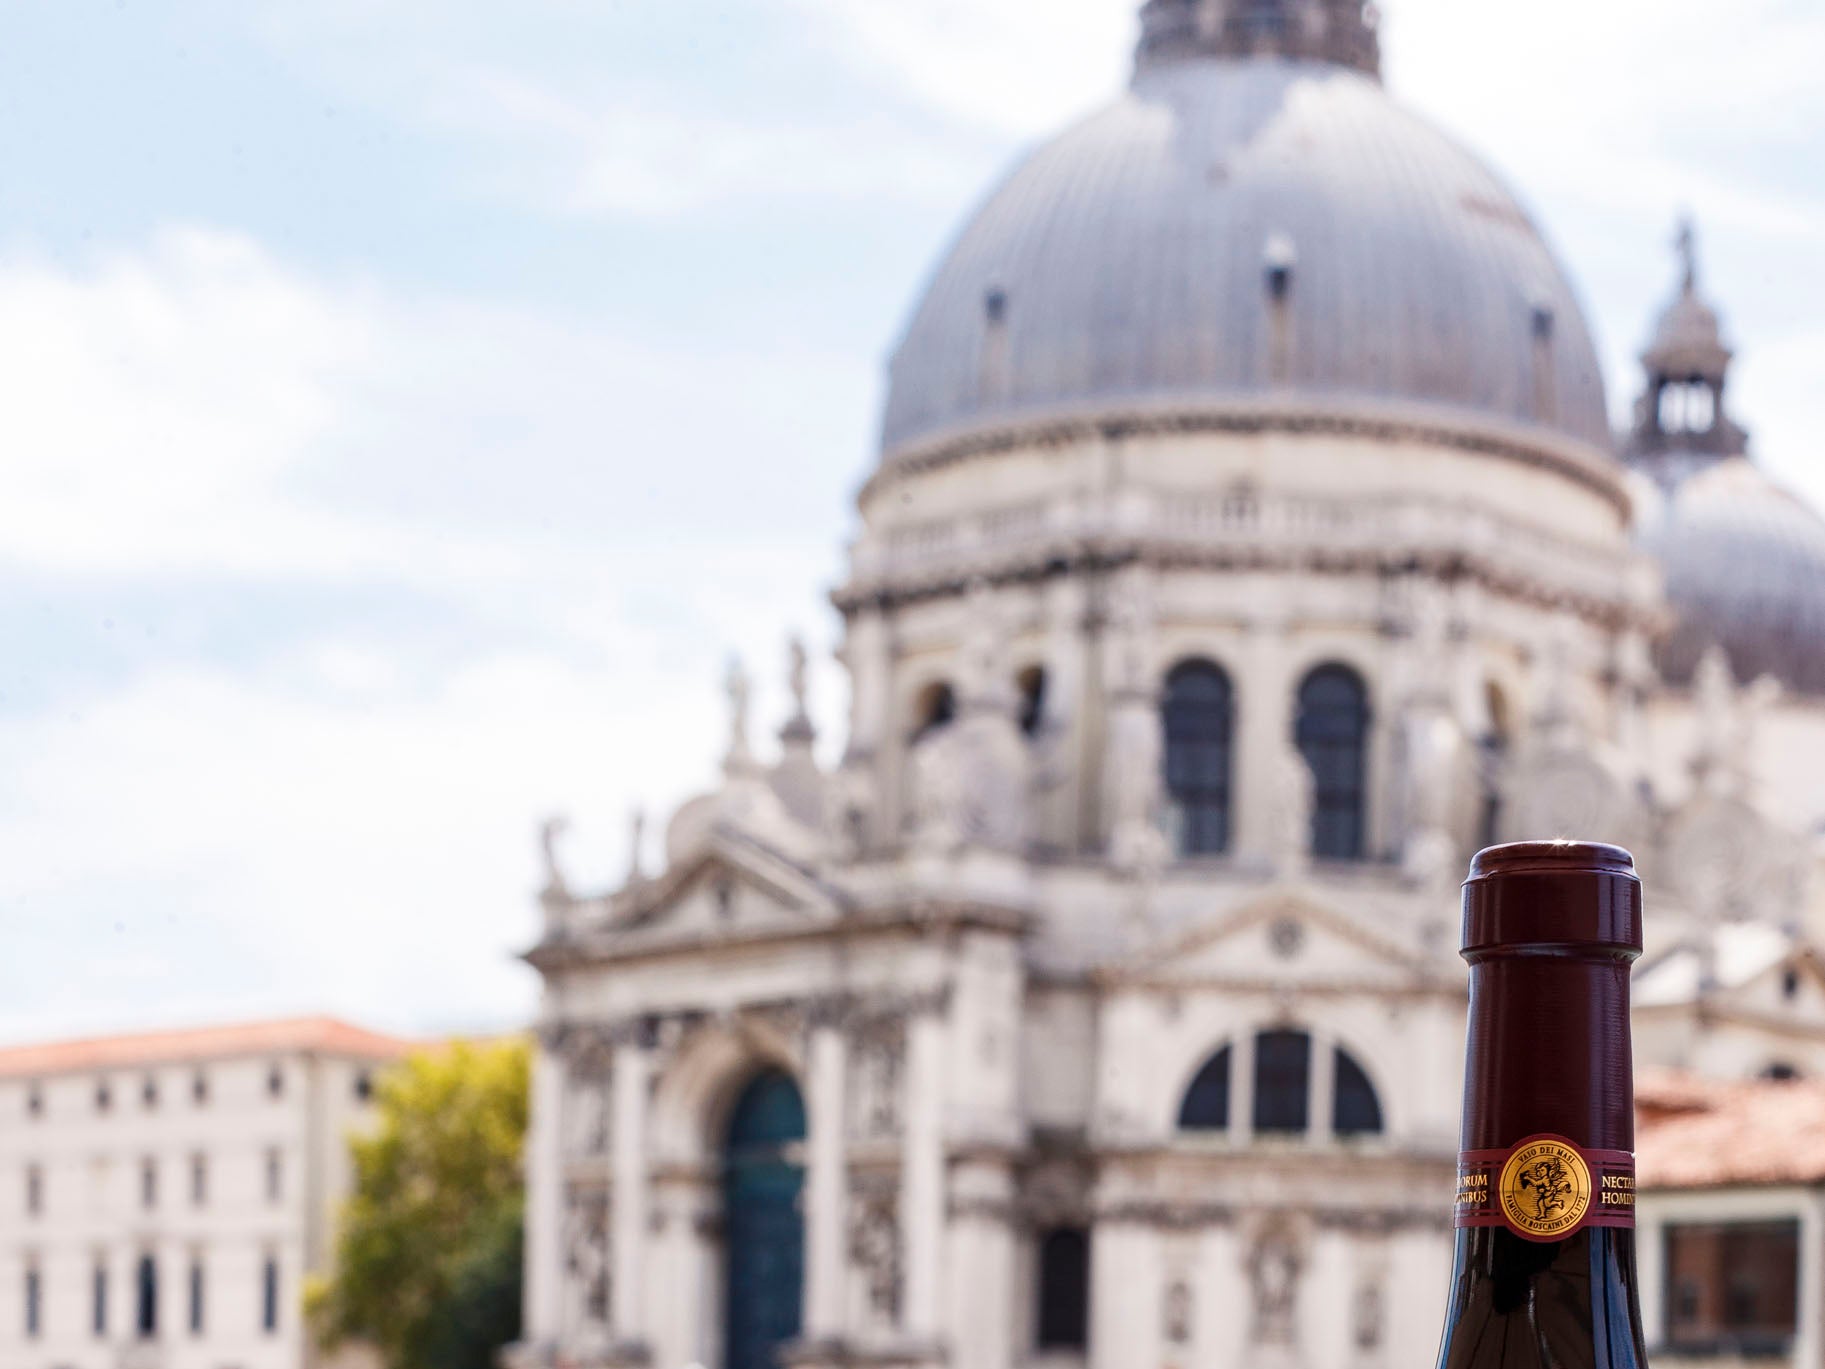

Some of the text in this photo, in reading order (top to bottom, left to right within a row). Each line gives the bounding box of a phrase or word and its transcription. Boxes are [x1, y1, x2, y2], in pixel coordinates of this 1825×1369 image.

[1539, 1146, 1554, 1154] DEI
[1557, 1148, 1575, 1164] MASI
[1505, 1194, 1586, 1230] FAMIGLIA BOSCAINI DAL 1772
